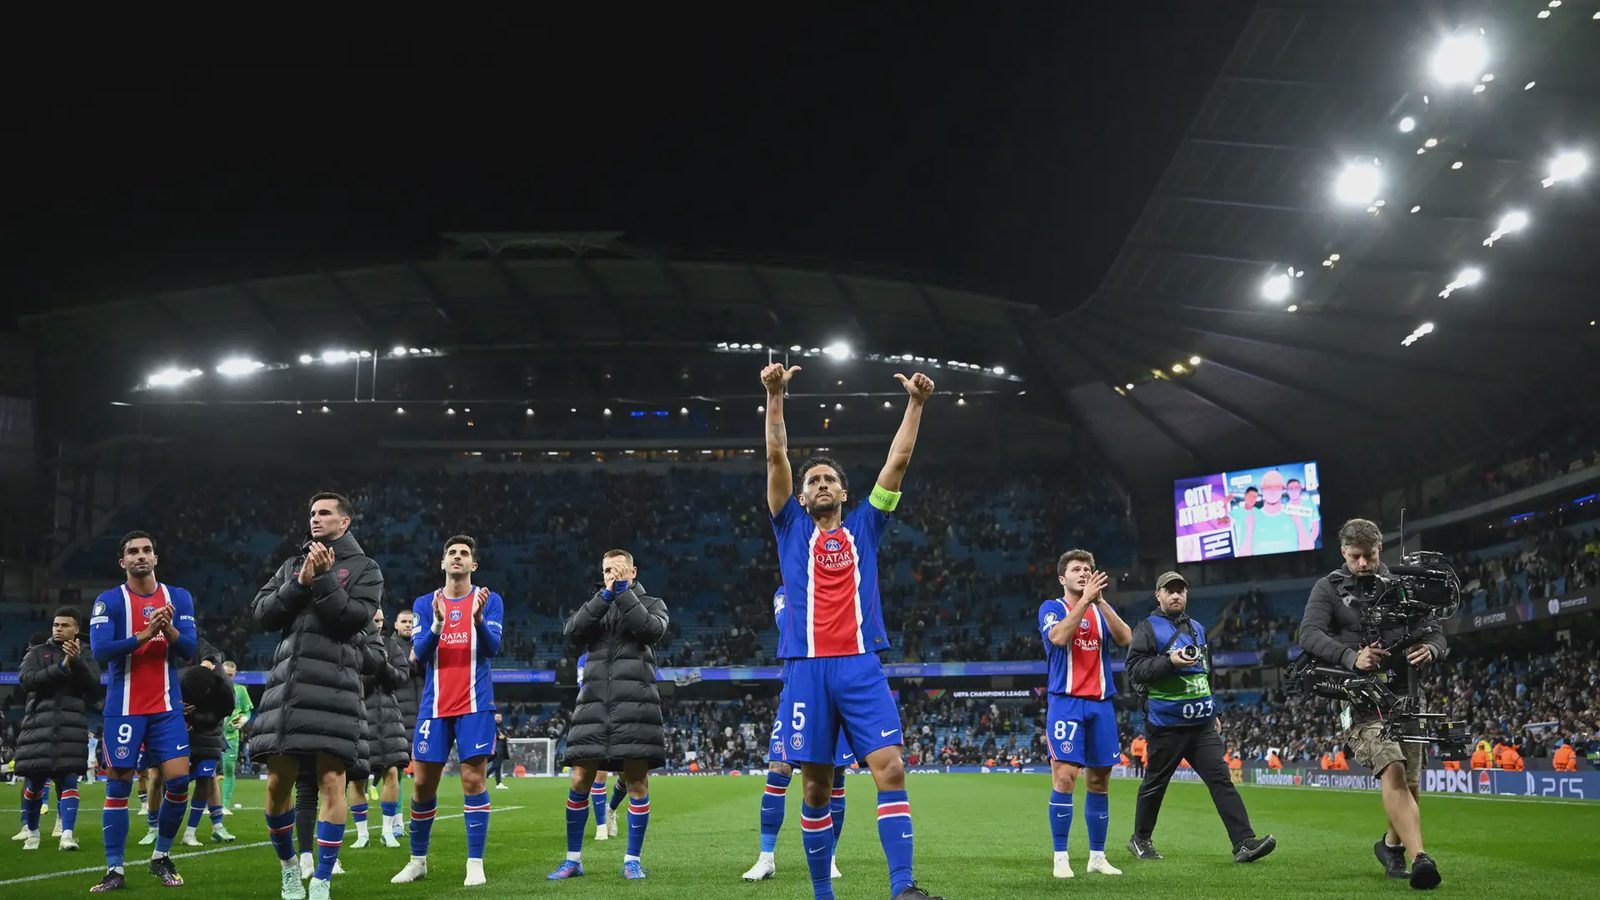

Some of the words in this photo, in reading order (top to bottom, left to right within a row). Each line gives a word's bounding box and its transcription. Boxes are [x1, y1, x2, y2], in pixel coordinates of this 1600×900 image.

[1184, 484, 1212, 507] CITY
[815, 551, 851, 564] QATAR
[825, 560, 853, 569] AIRWAYS
[440, 632, 468, 642] QATAR
[791, 702, 806, 731] 5
[1182, 700, 1214, 719] 023
[117, 723, 133, 744] 9
[418, 719, 431, 740] 4
[771, 720, 783, 740] 2
[1054, 720, 1078, 741] 87
[1331, 775, 1366, 790] CHAMPIONS
[1425, 769, 1473, 794] PEPSI
[1542, 777, 1584, 800] PS5
